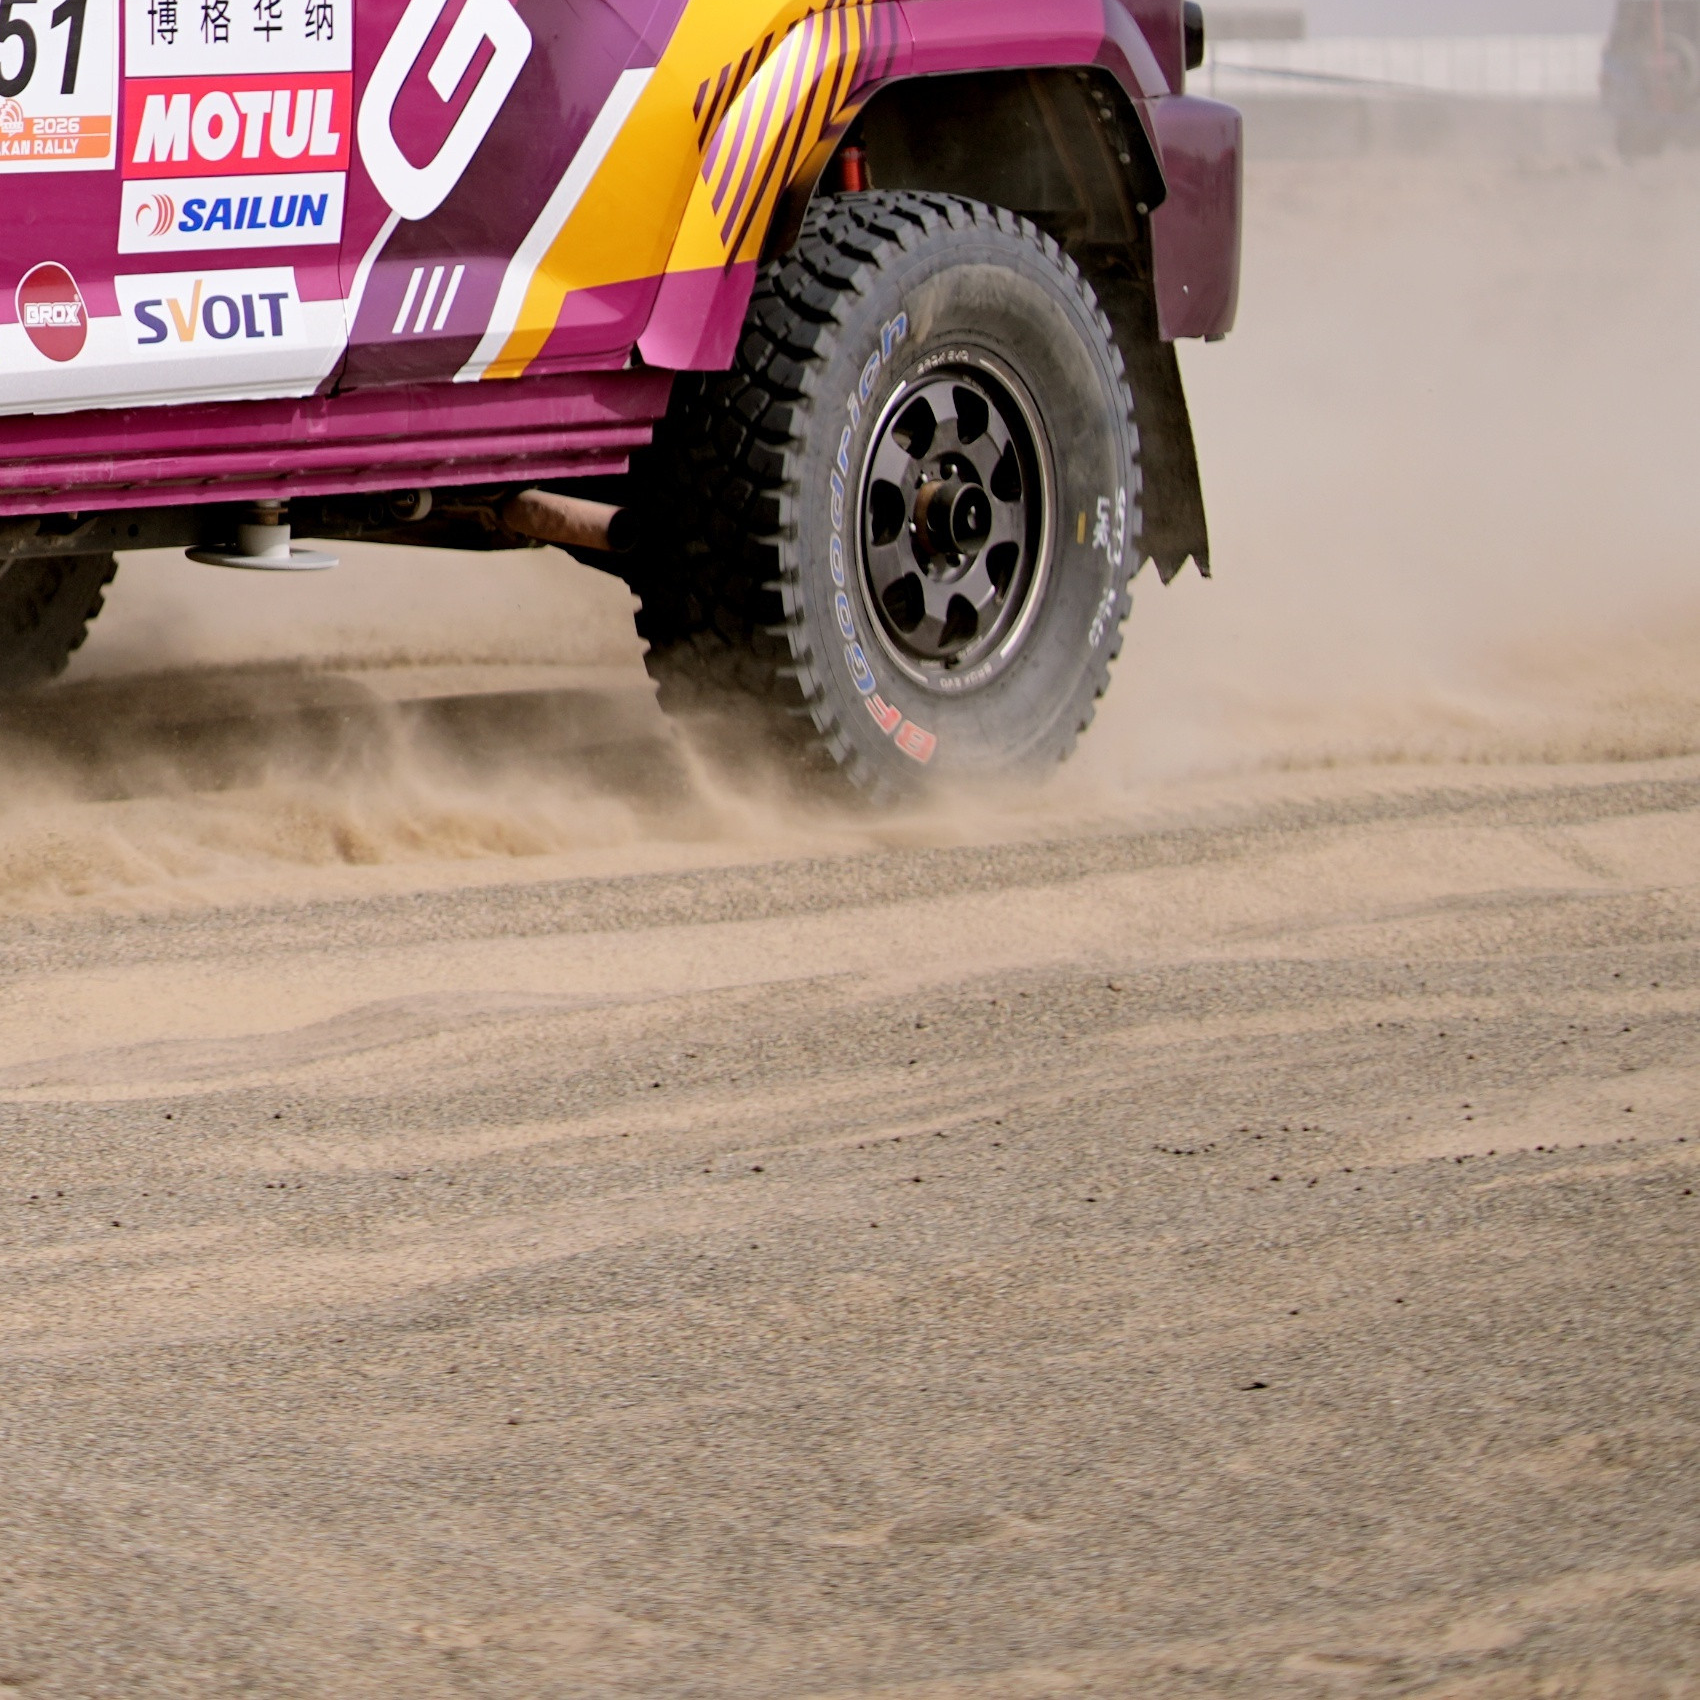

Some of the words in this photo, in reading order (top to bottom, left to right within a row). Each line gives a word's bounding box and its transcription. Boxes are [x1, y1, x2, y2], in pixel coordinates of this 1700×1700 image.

[32, 117, 80, 134] 2026
[131, 88, 341, 164] MOTUL
[33, 138, 79, 155] RALLY
[178, 193, 329, 232] SAILUN
[23, 301, 81, 328] BROX
[134, 279, 290, 346] SVOLT
